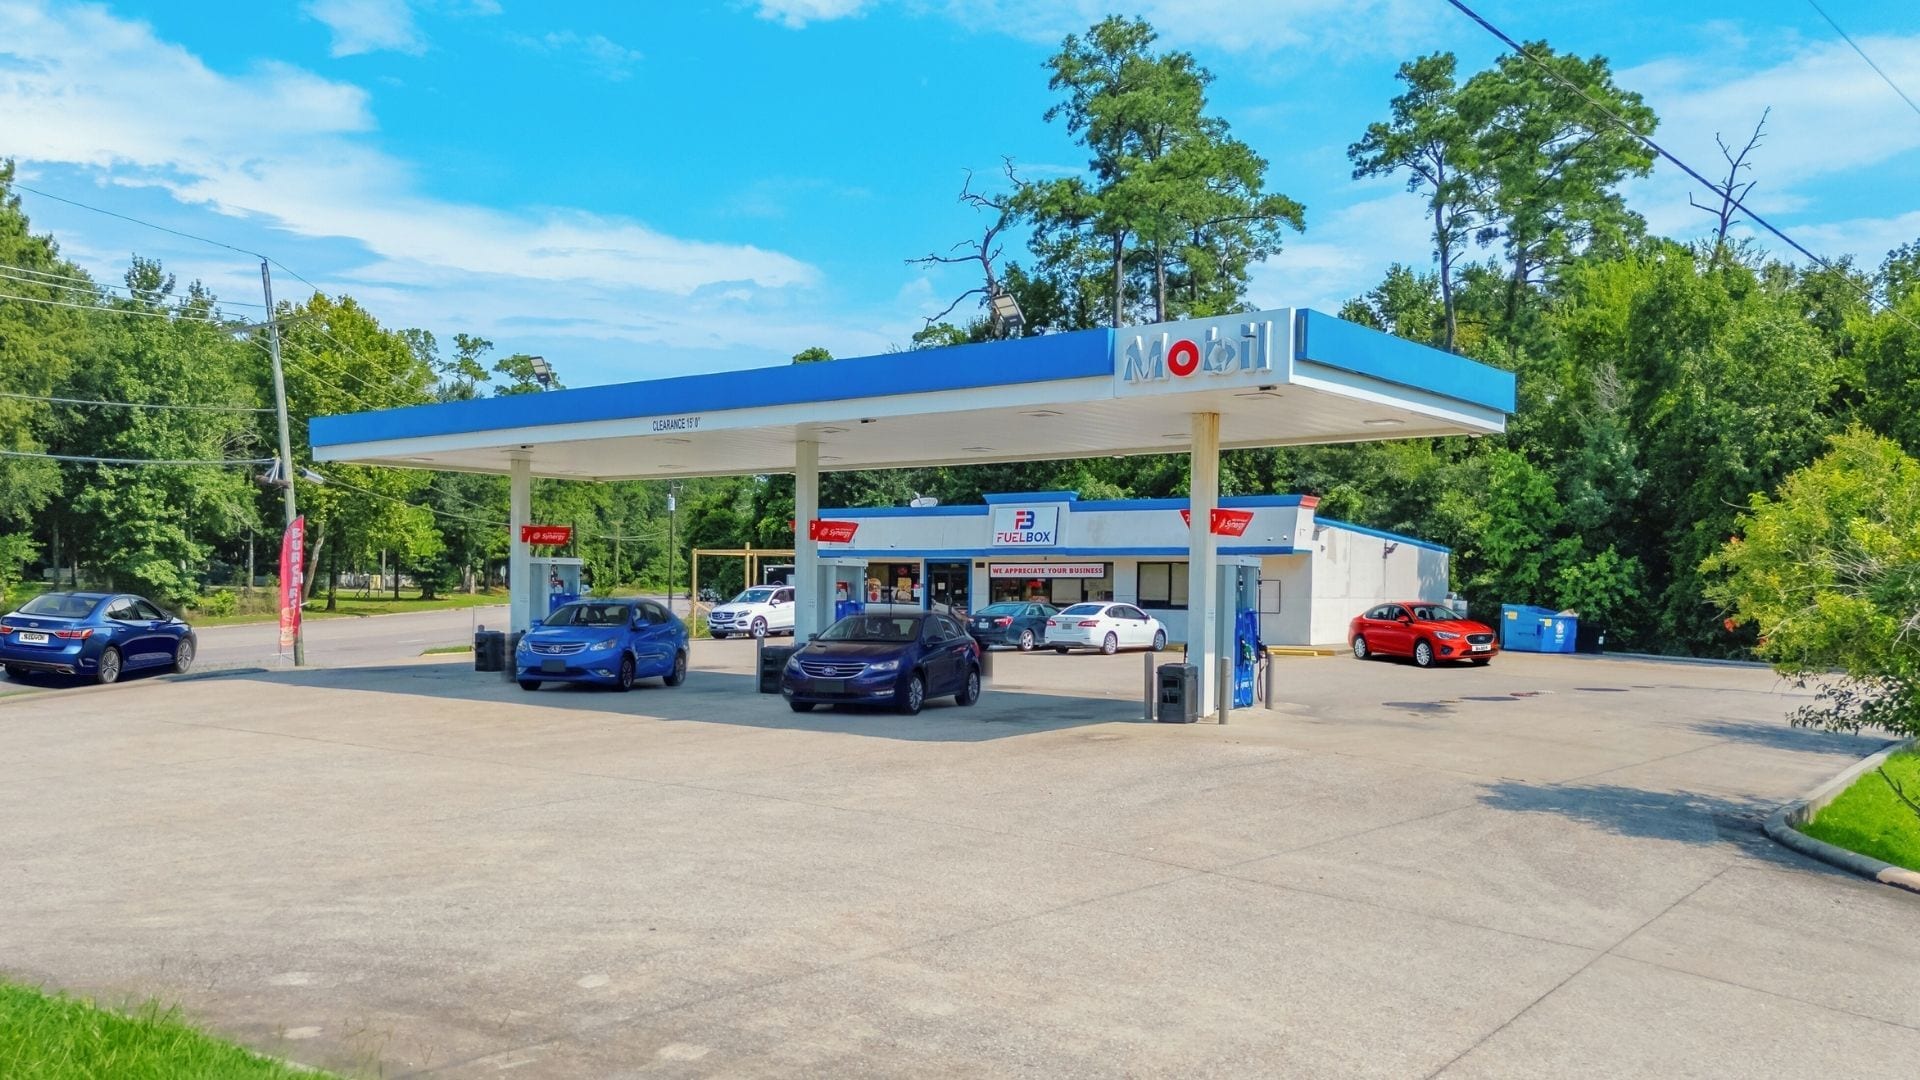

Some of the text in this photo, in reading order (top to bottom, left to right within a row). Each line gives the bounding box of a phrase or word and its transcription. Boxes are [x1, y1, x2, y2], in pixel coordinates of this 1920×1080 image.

[1123, 320, 1272, 383] Mobil
[652, 418, 686, 431] CLEARANCE
[996, 531, 1051, 543] FUELBOX
[289, 528, 301, 608] BURGERS
